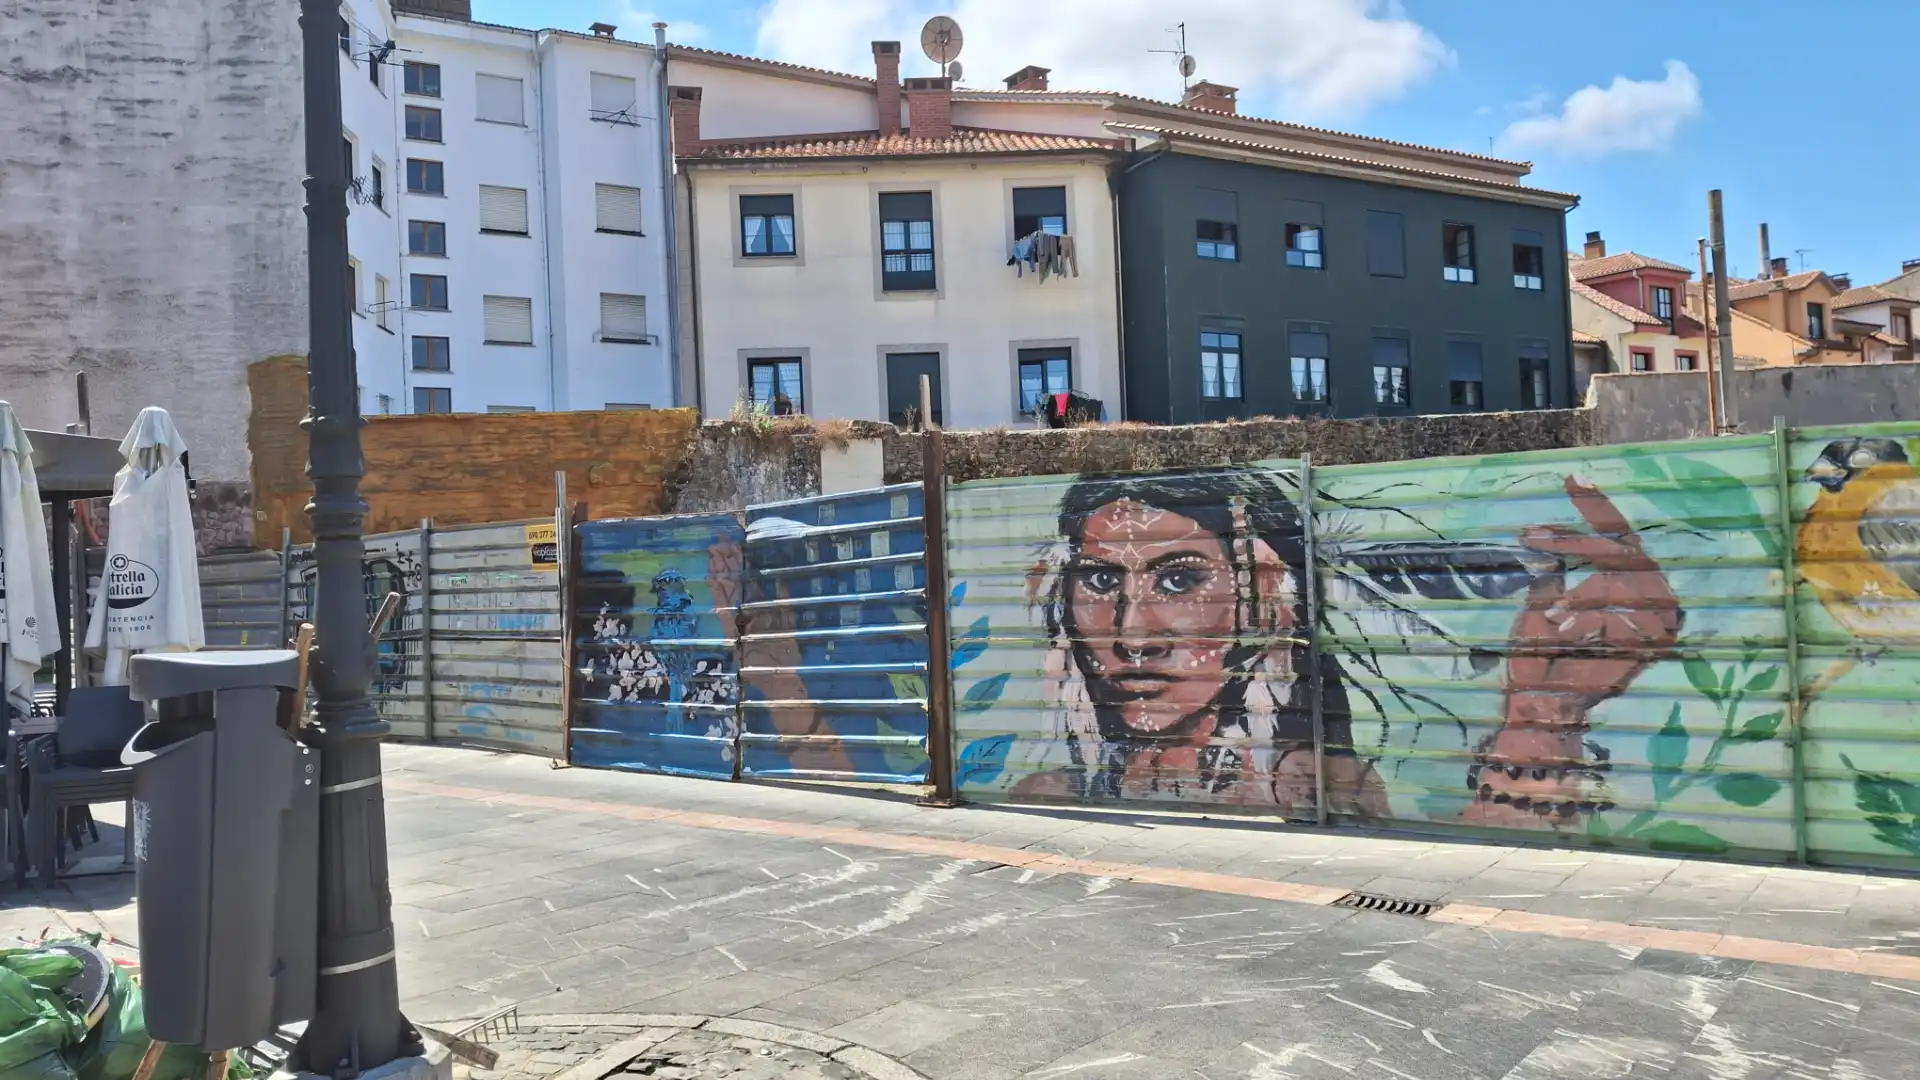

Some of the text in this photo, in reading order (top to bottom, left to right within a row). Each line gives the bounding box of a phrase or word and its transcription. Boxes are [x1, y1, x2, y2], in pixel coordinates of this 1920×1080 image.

[109, 571, 145, 582] trella
[108, 583, 143, 595] alicia
[108, 615, 155, 623] ISTENCIA
